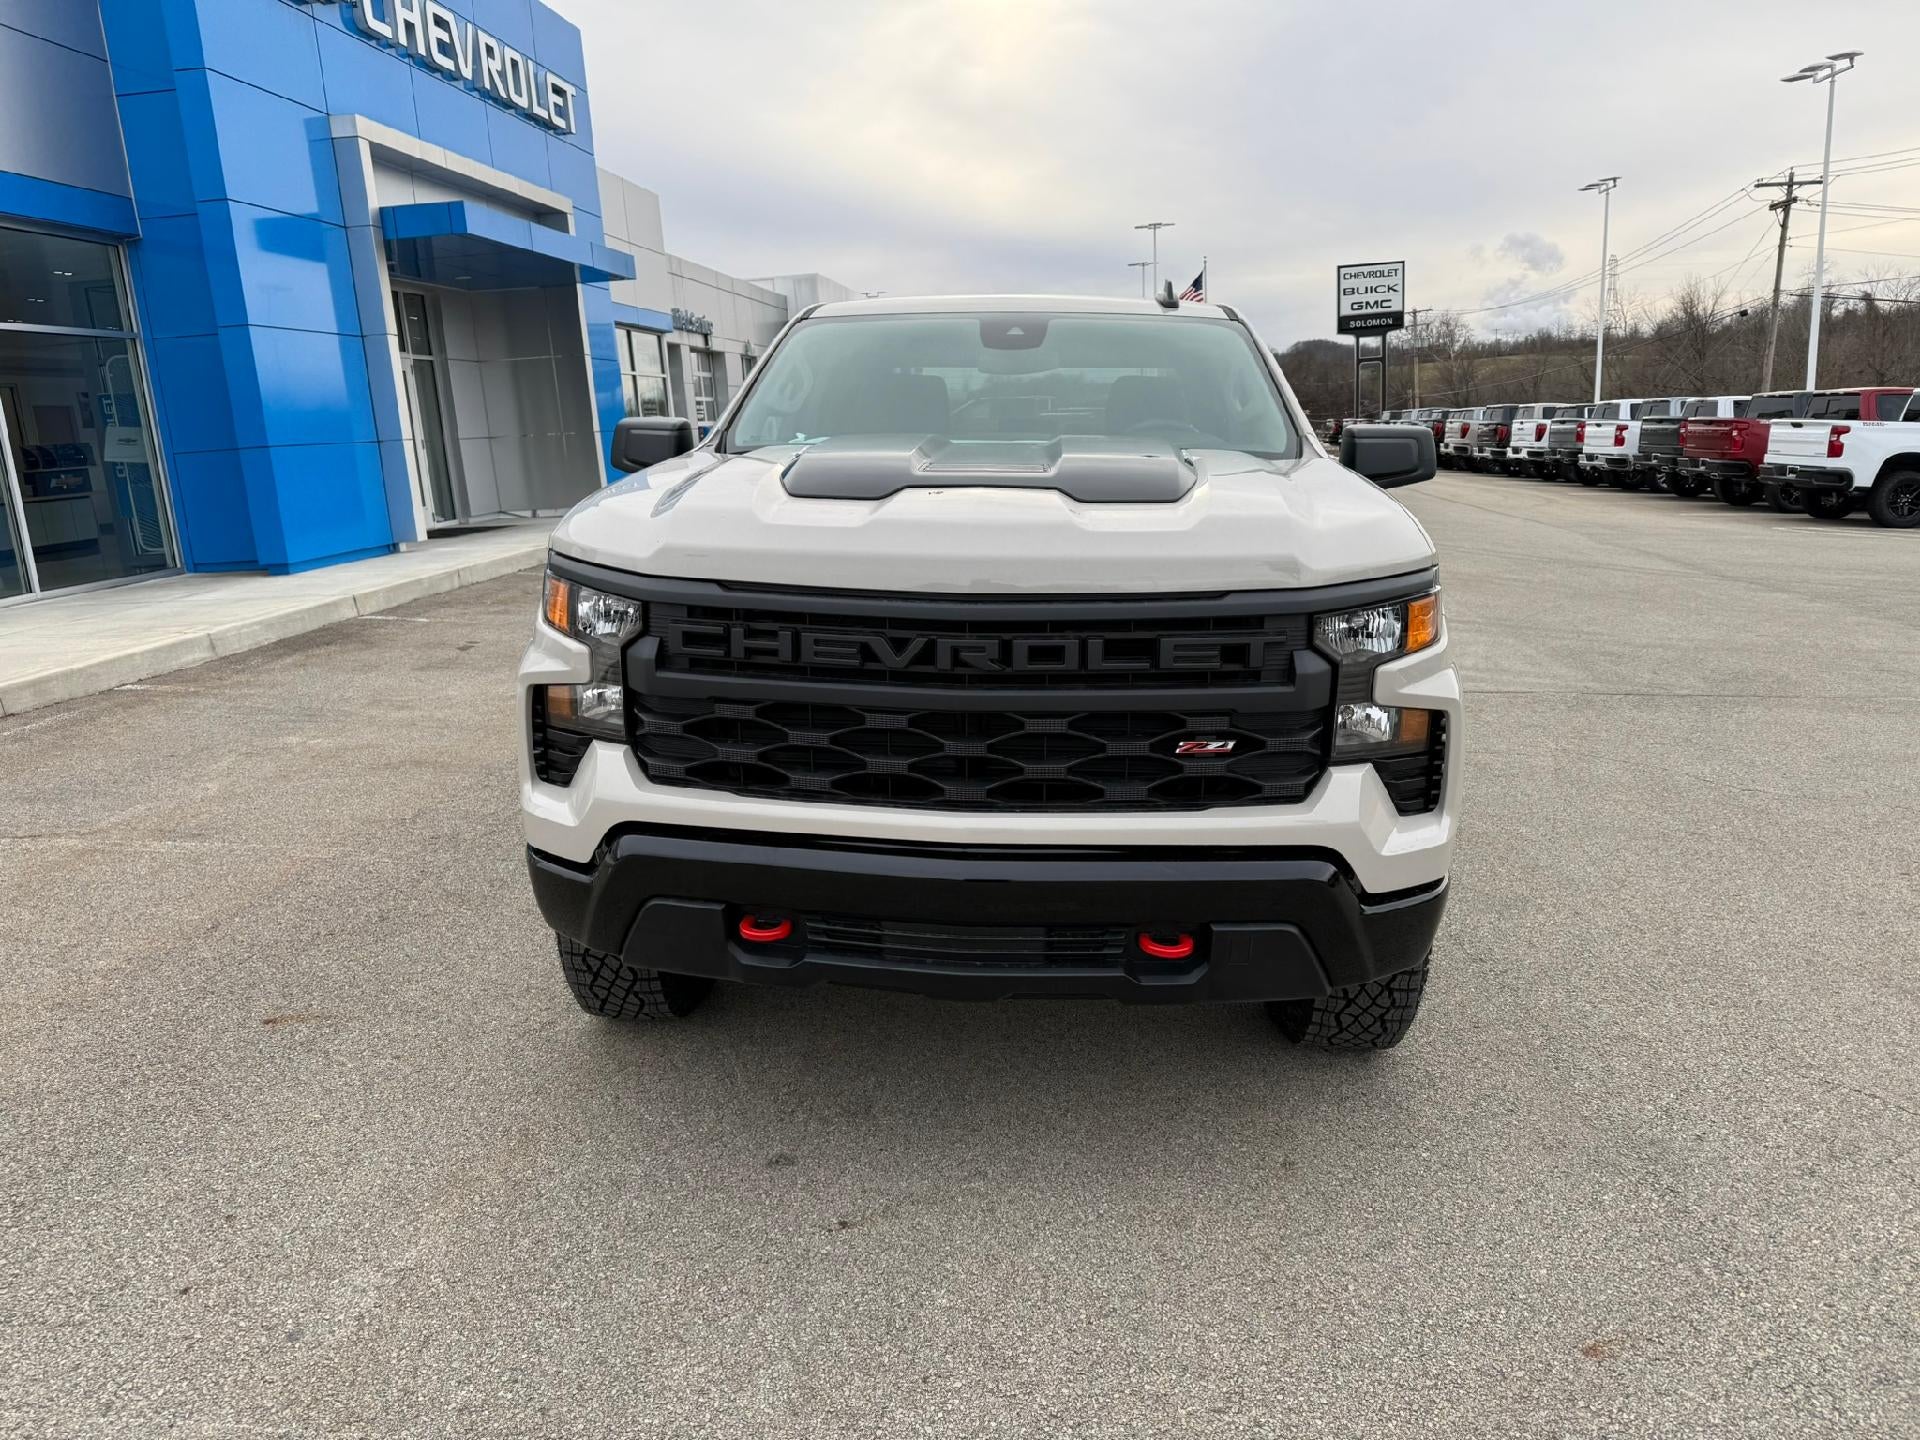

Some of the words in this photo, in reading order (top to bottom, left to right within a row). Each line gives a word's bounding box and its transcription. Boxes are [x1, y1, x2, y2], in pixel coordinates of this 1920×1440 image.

[1343, 268, 1400, 280] CHEVROLET
[1343, 284, 1399, 296] BUICK
[1350, 299, 1392, 311] GMC
[1349, 318, 1393, 328] SOLOMON
[670, 622, 1288, 671] CHEVROLET
[1175, 740, 1237, 754] Z71
